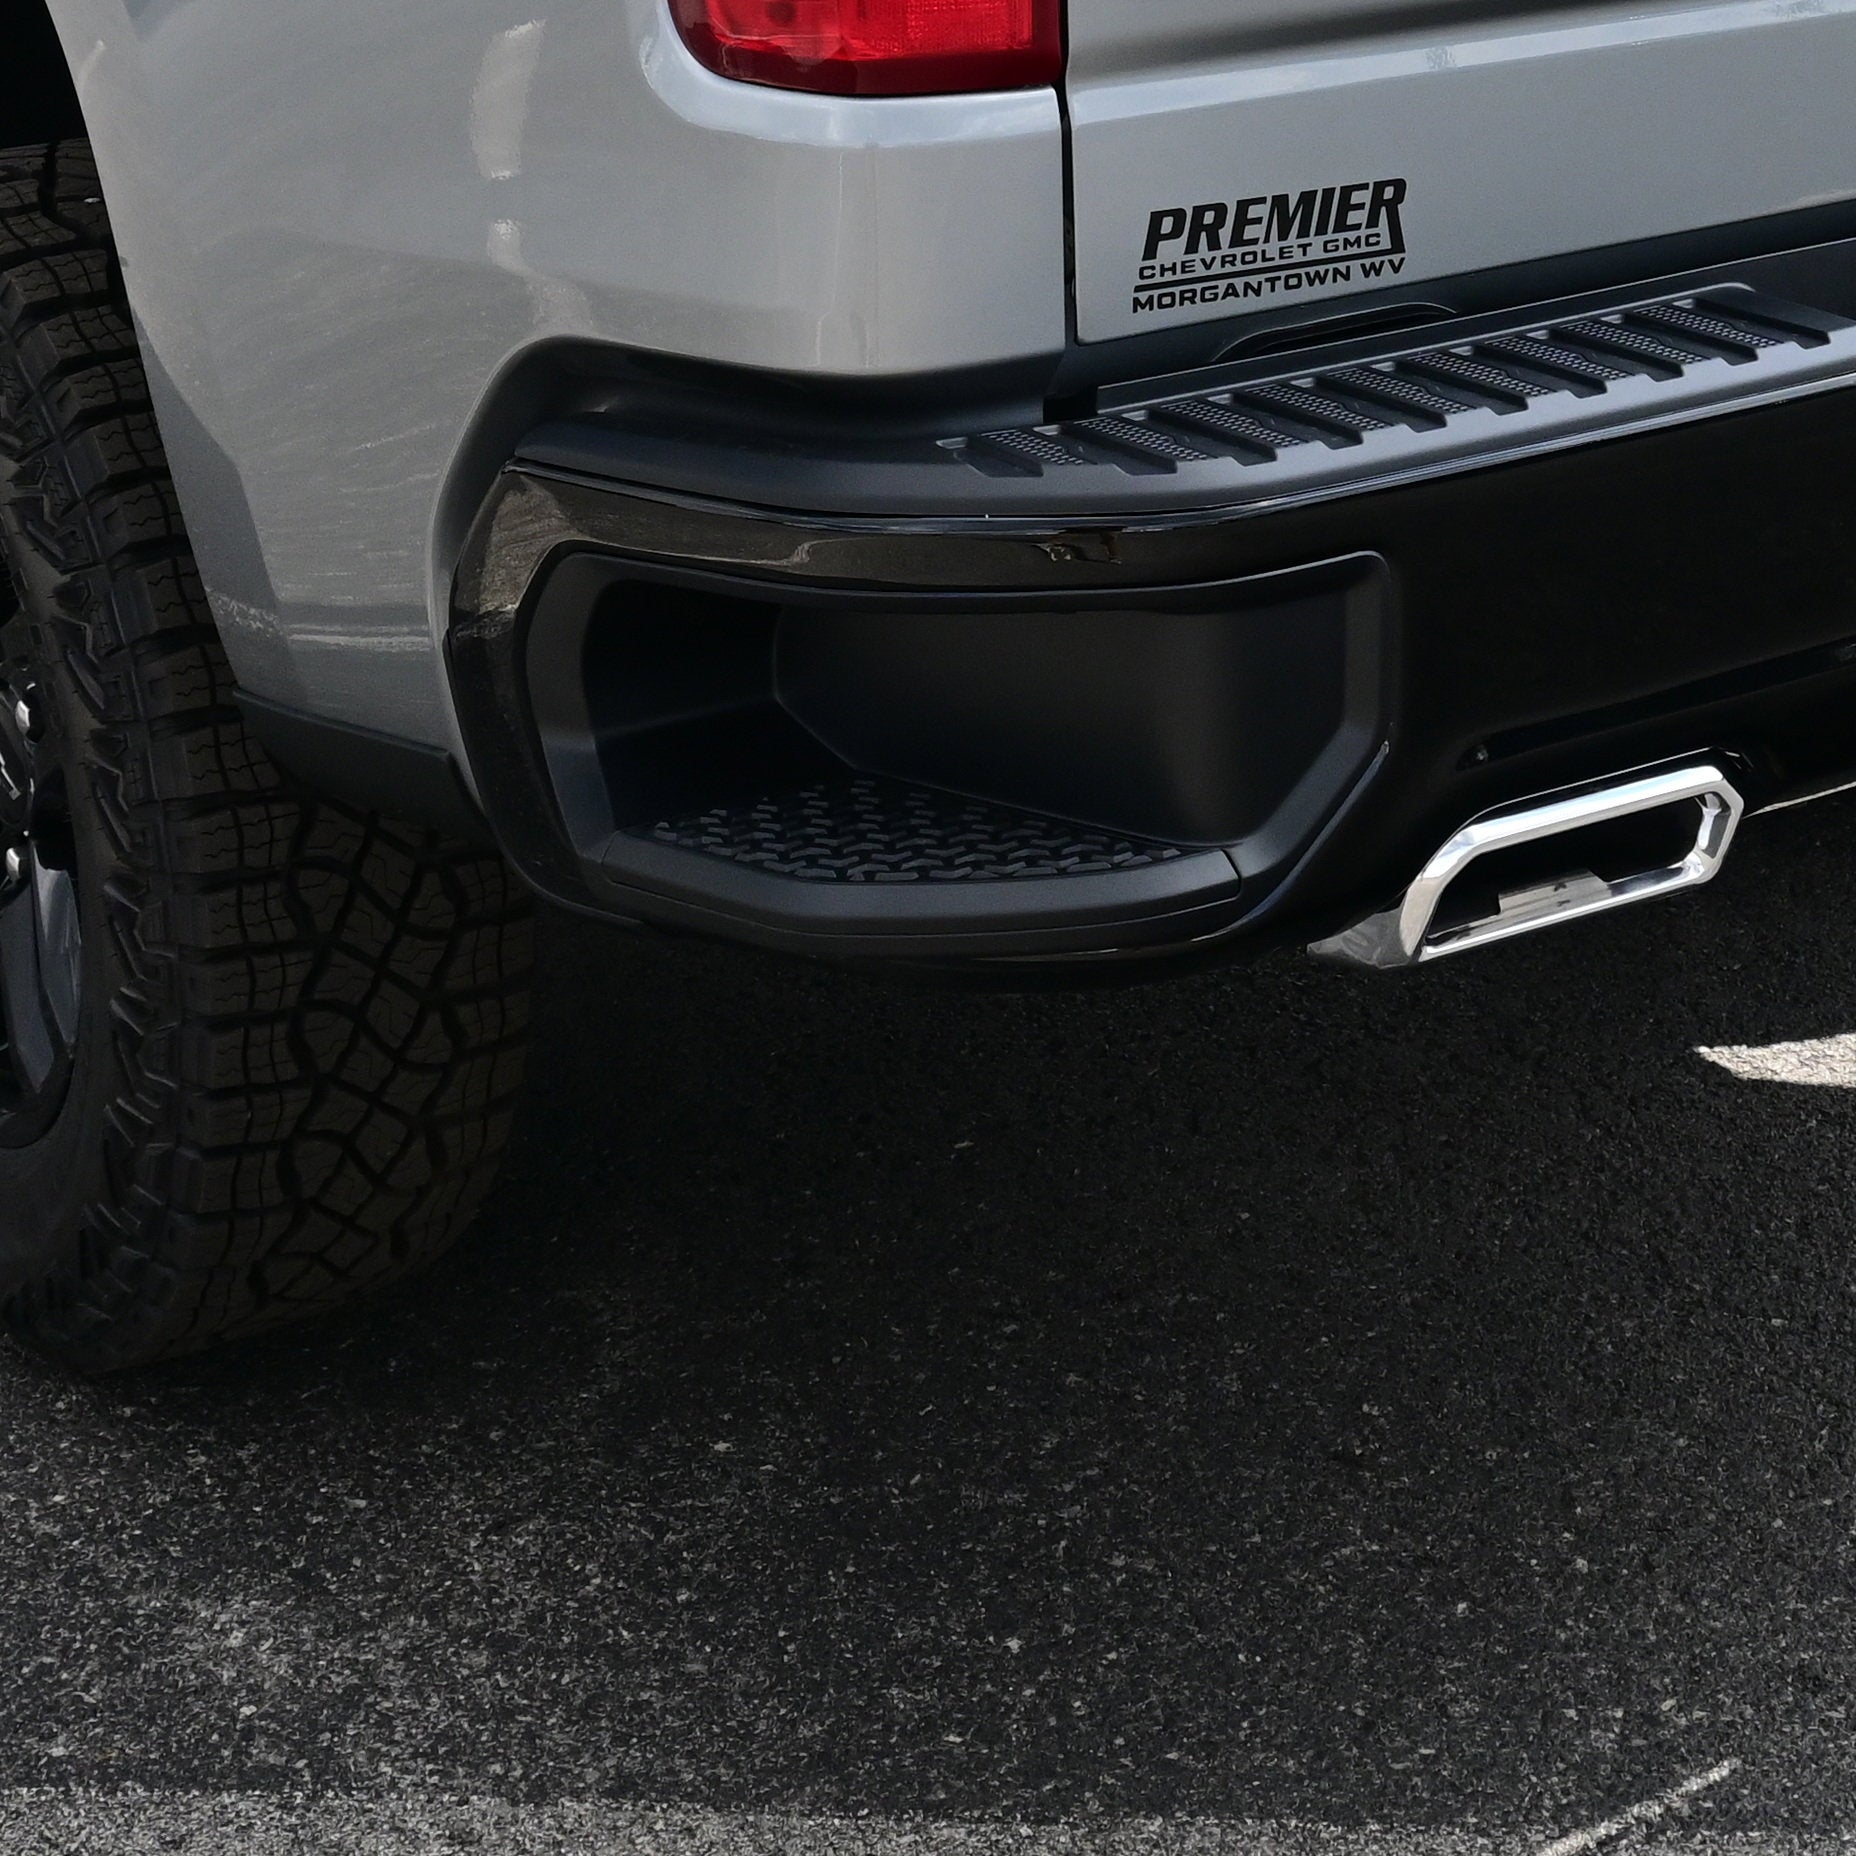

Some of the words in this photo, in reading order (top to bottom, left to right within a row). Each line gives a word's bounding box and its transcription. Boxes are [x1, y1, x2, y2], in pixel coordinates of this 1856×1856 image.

[1142, 177, 1407, 262] PREMIER
[1138, 242, 1313, 281] CHEVROLET
[1322, 231, 1382, 254] GMC
[1131, 265, 1351, 314] MORGANTOWN
[1360, 257, 1406, 279] WV
